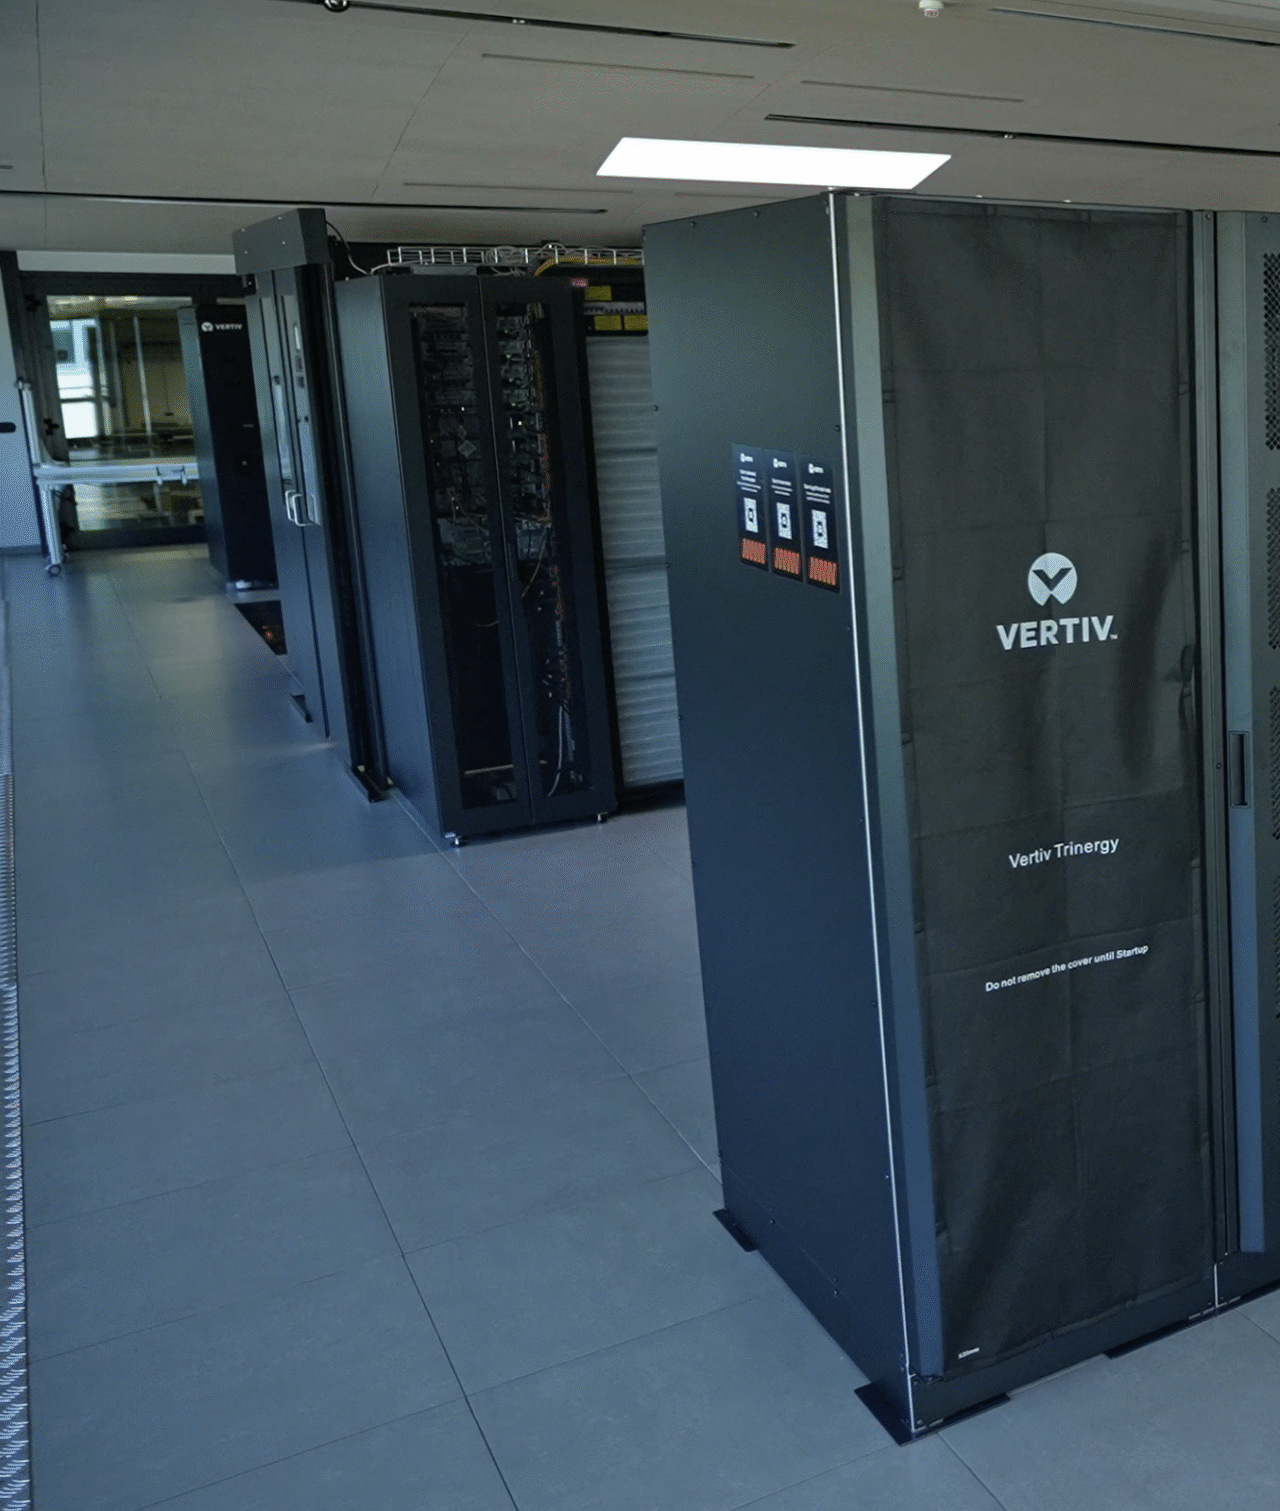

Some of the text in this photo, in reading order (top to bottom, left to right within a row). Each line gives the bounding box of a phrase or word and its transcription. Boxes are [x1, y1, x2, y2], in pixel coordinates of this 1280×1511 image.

[1009, 838, 1119, 868] Vertiv Trinergy
[985, 944, 1149, 992] Do not remove the cover until Startup
